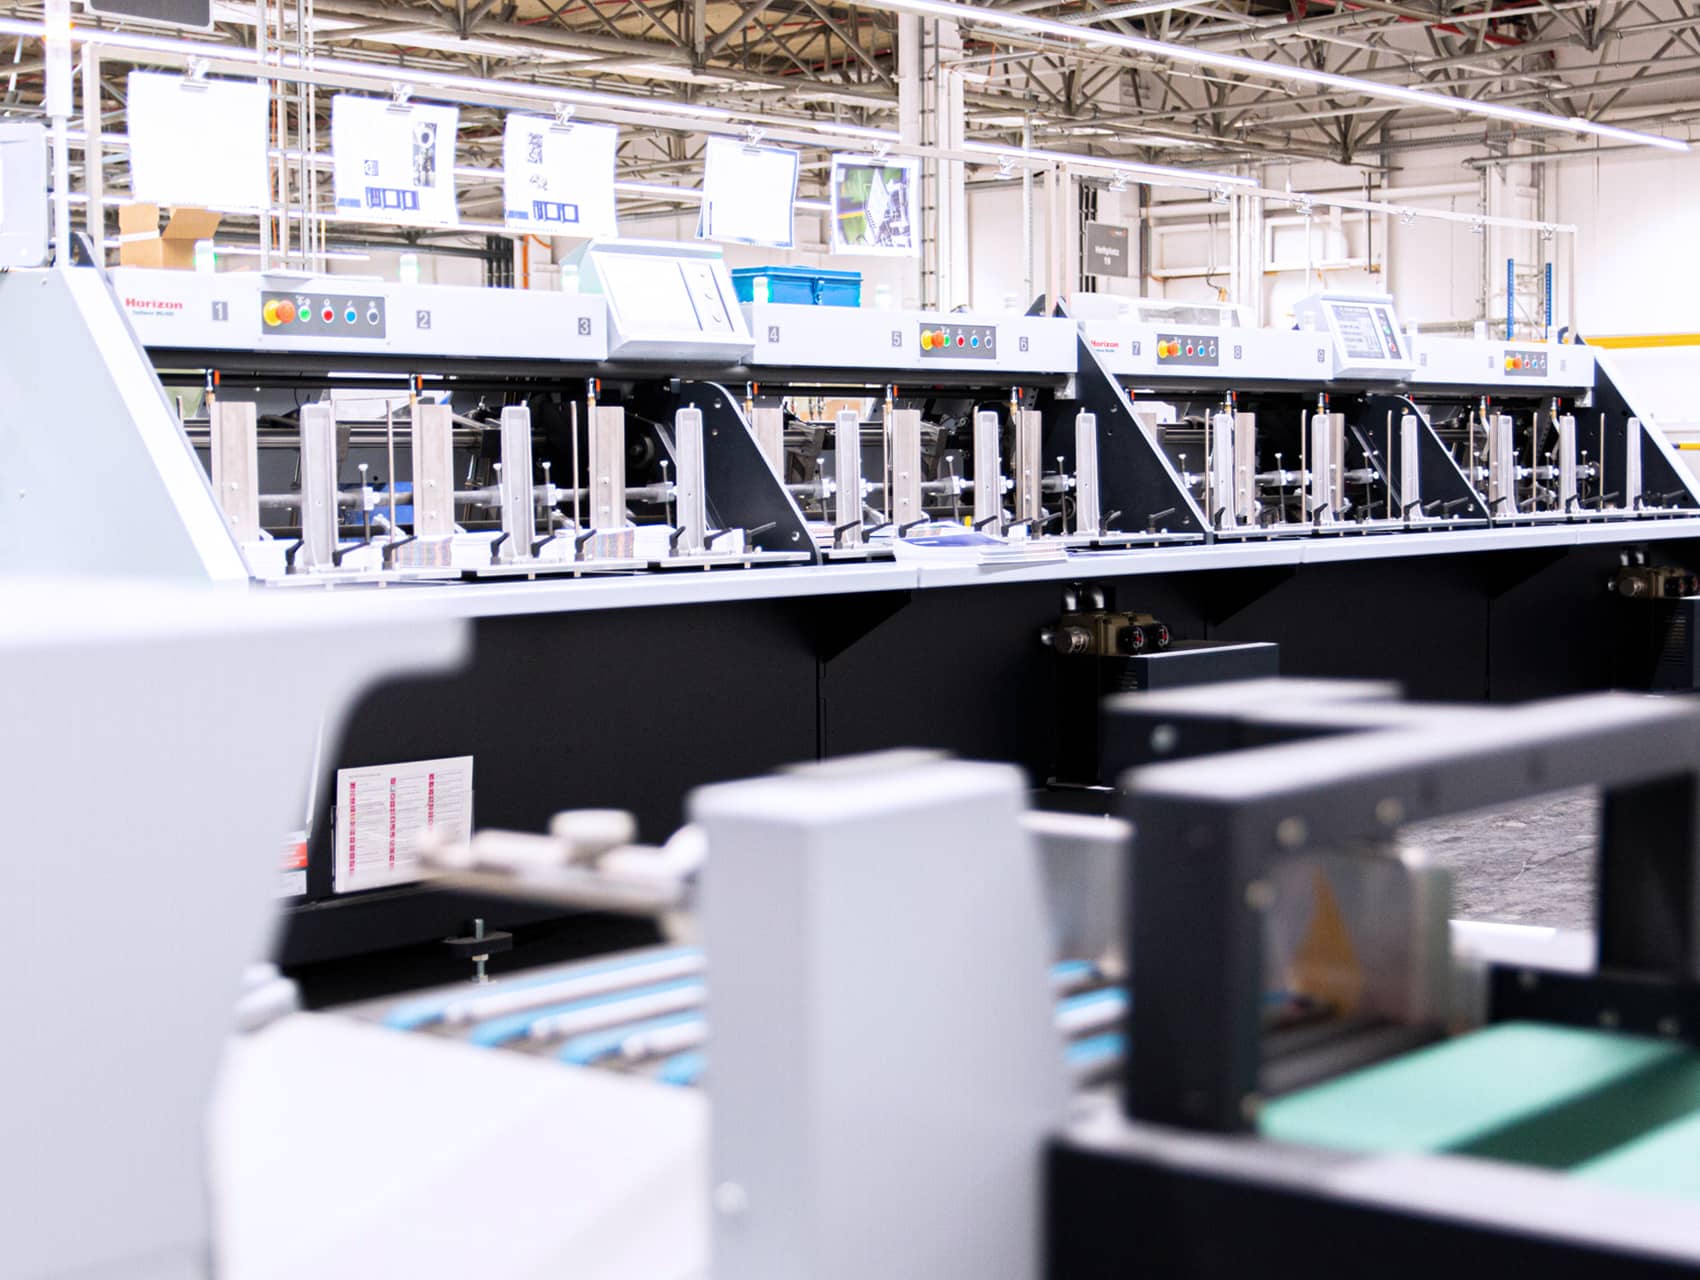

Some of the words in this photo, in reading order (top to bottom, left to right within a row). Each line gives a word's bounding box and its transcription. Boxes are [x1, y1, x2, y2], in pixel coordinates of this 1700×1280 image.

[125, 298, 183, 310] Horizon
[418, 311, 430, 328] 2
[579, 318, 590, 335] 3
[769, 327, 779, 342] 4
